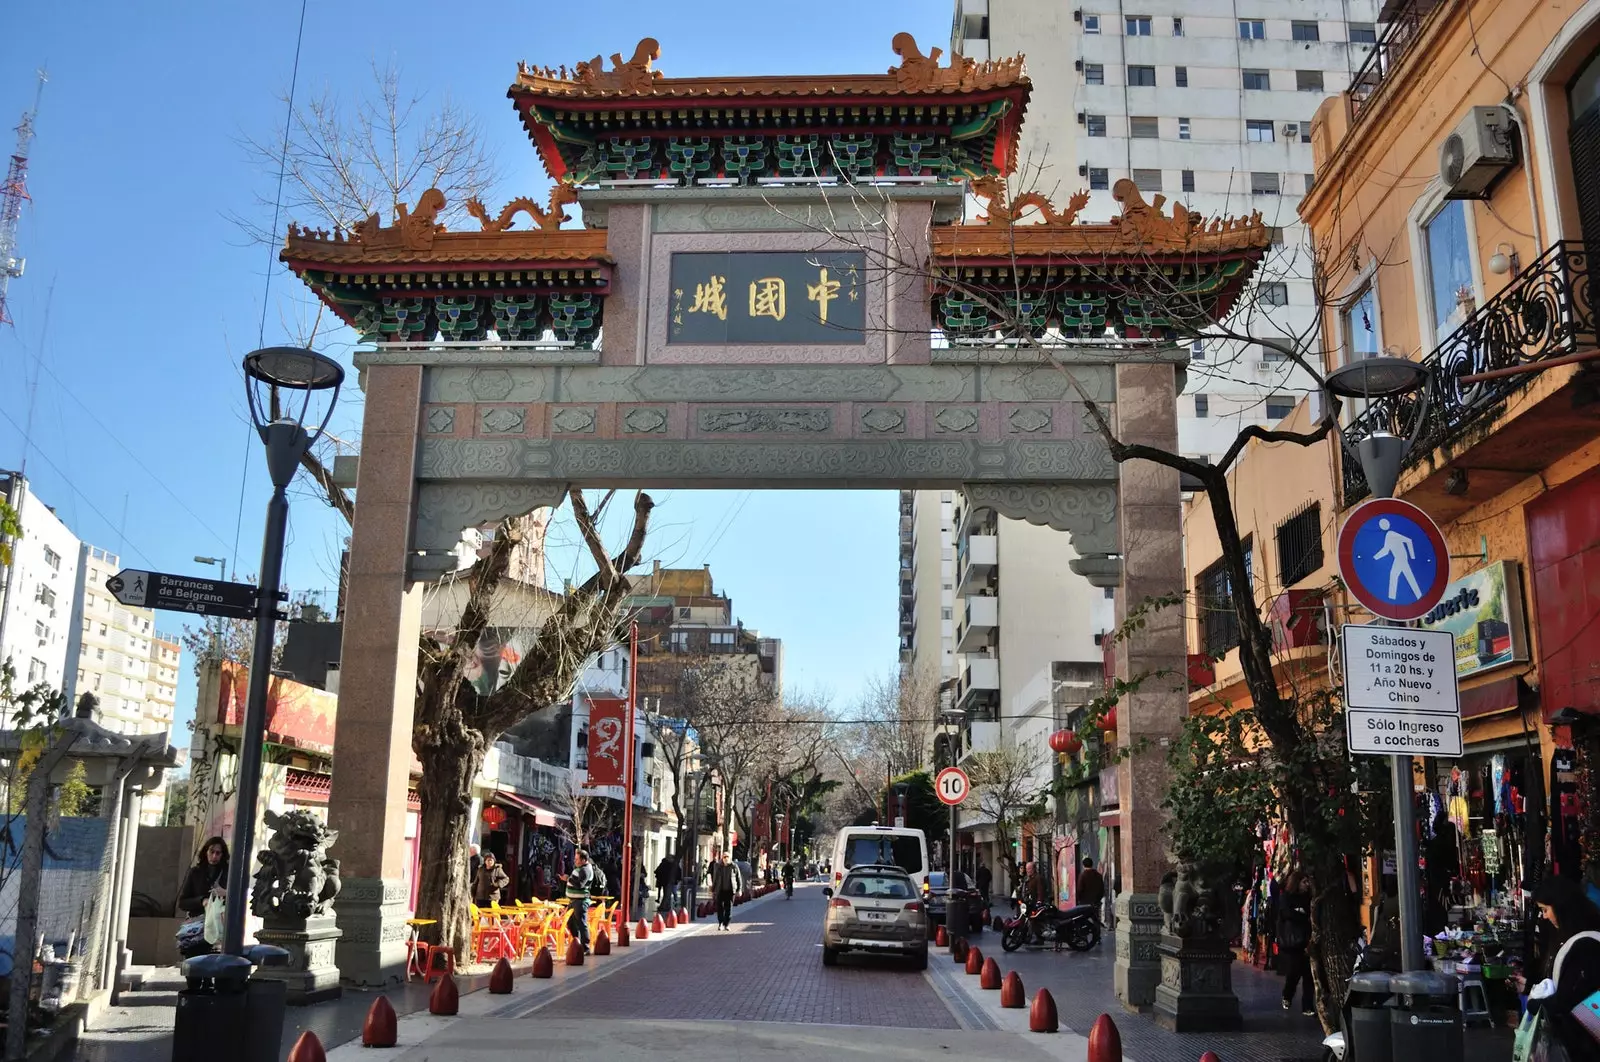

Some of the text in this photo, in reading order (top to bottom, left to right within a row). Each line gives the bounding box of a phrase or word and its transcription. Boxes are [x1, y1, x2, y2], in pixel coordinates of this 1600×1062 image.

[160, 575, 214, 591] Barrancas
[129, 593, 143, 601] min
[159, 587, 224, 603] de Belgrano
[1371, 635, 1426, 650] Sábados y
[1366, 648, 1435, 662] Domingos de
[1369, 663, 1433, 677] 11 a 20 hs. y
[1373, 677, 1432, 690] Año Nuevo
[1388, 691, 1420, 703] Chino
[1367, 718, 1444, 734] Sólo Ingreso
[1373, 735, 1440, 747] a cocheras
[942, 778, 962, 794] 10
